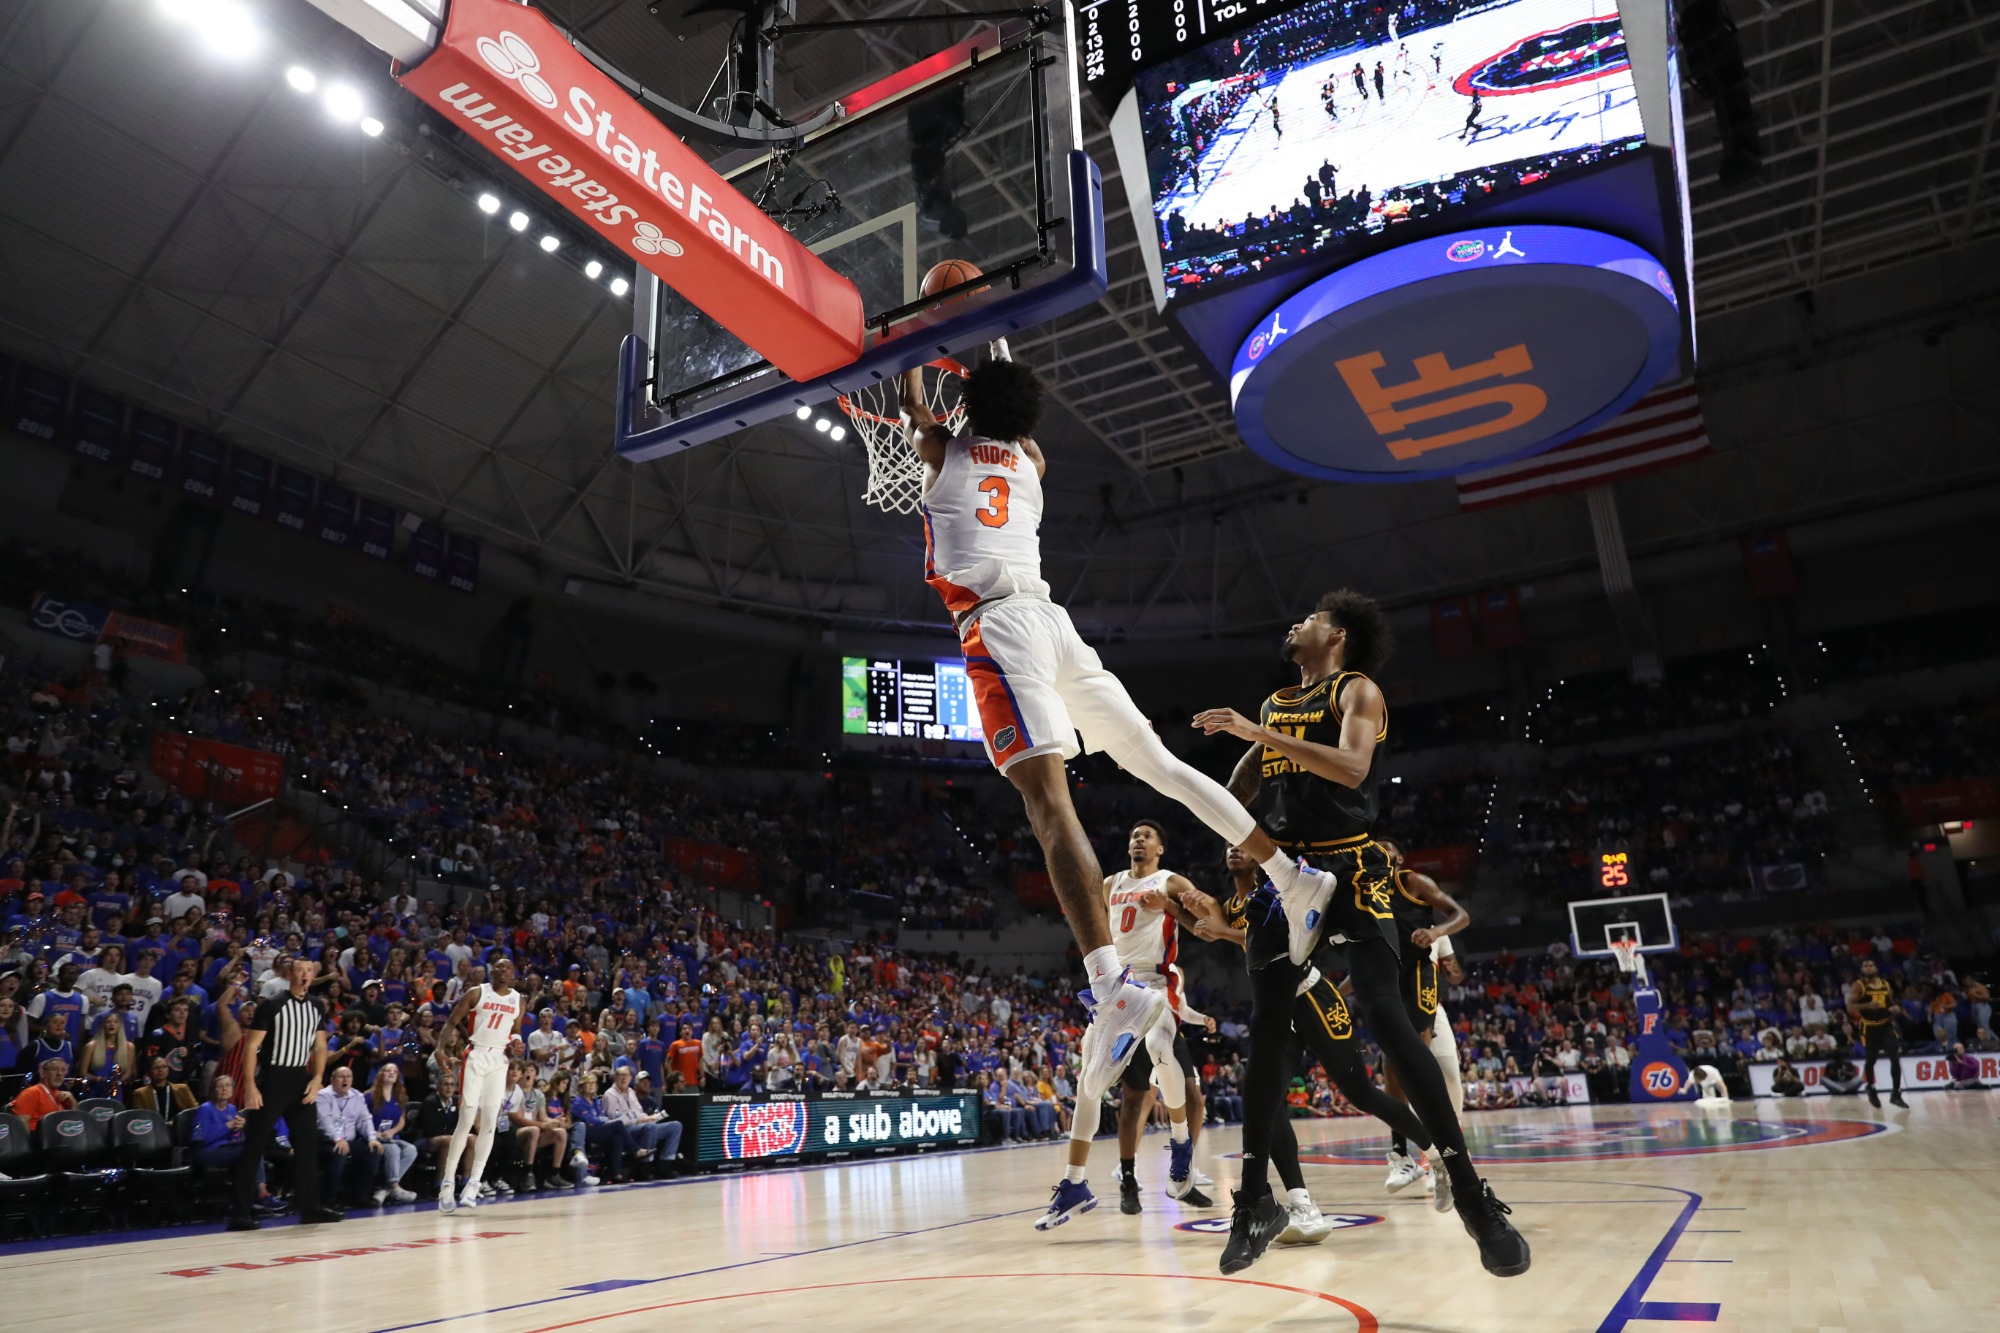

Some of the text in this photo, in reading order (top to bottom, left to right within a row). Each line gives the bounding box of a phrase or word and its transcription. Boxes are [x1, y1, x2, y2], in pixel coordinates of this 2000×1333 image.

[1088, 7, 1098, 20] 0
[1088, 4, 1138, 36] 2 2
[1213, 2, 1247, 22] TOL
[1086, 34, 1103, 51] 13
[1129, 18, 1139, 32] 0
[1086, 14, 1185, 67] 22 0 0
[1087, 28, 1187, 81] 24 0 0
[1334, 343, 1548, 461] UF
[968, 444, 1019, 473] FUDGE
[975, 475, 1011, 529] 3
[1602, 852, 1628, 865] 9:49
[1602, 864, 1628, 887] 25
[1120, 906, 1137, 933] 0
[482, 1002, 516, 1015] GATORS
[487, 1013, 503, 1030] 11
[1642, 1013, 1658, 1035] F
[1646, 1068, 1674, 1090] 76
[824, 1102, 963, 1144] a sub above
[158, 1231, 530, 1278] FLORIDA
